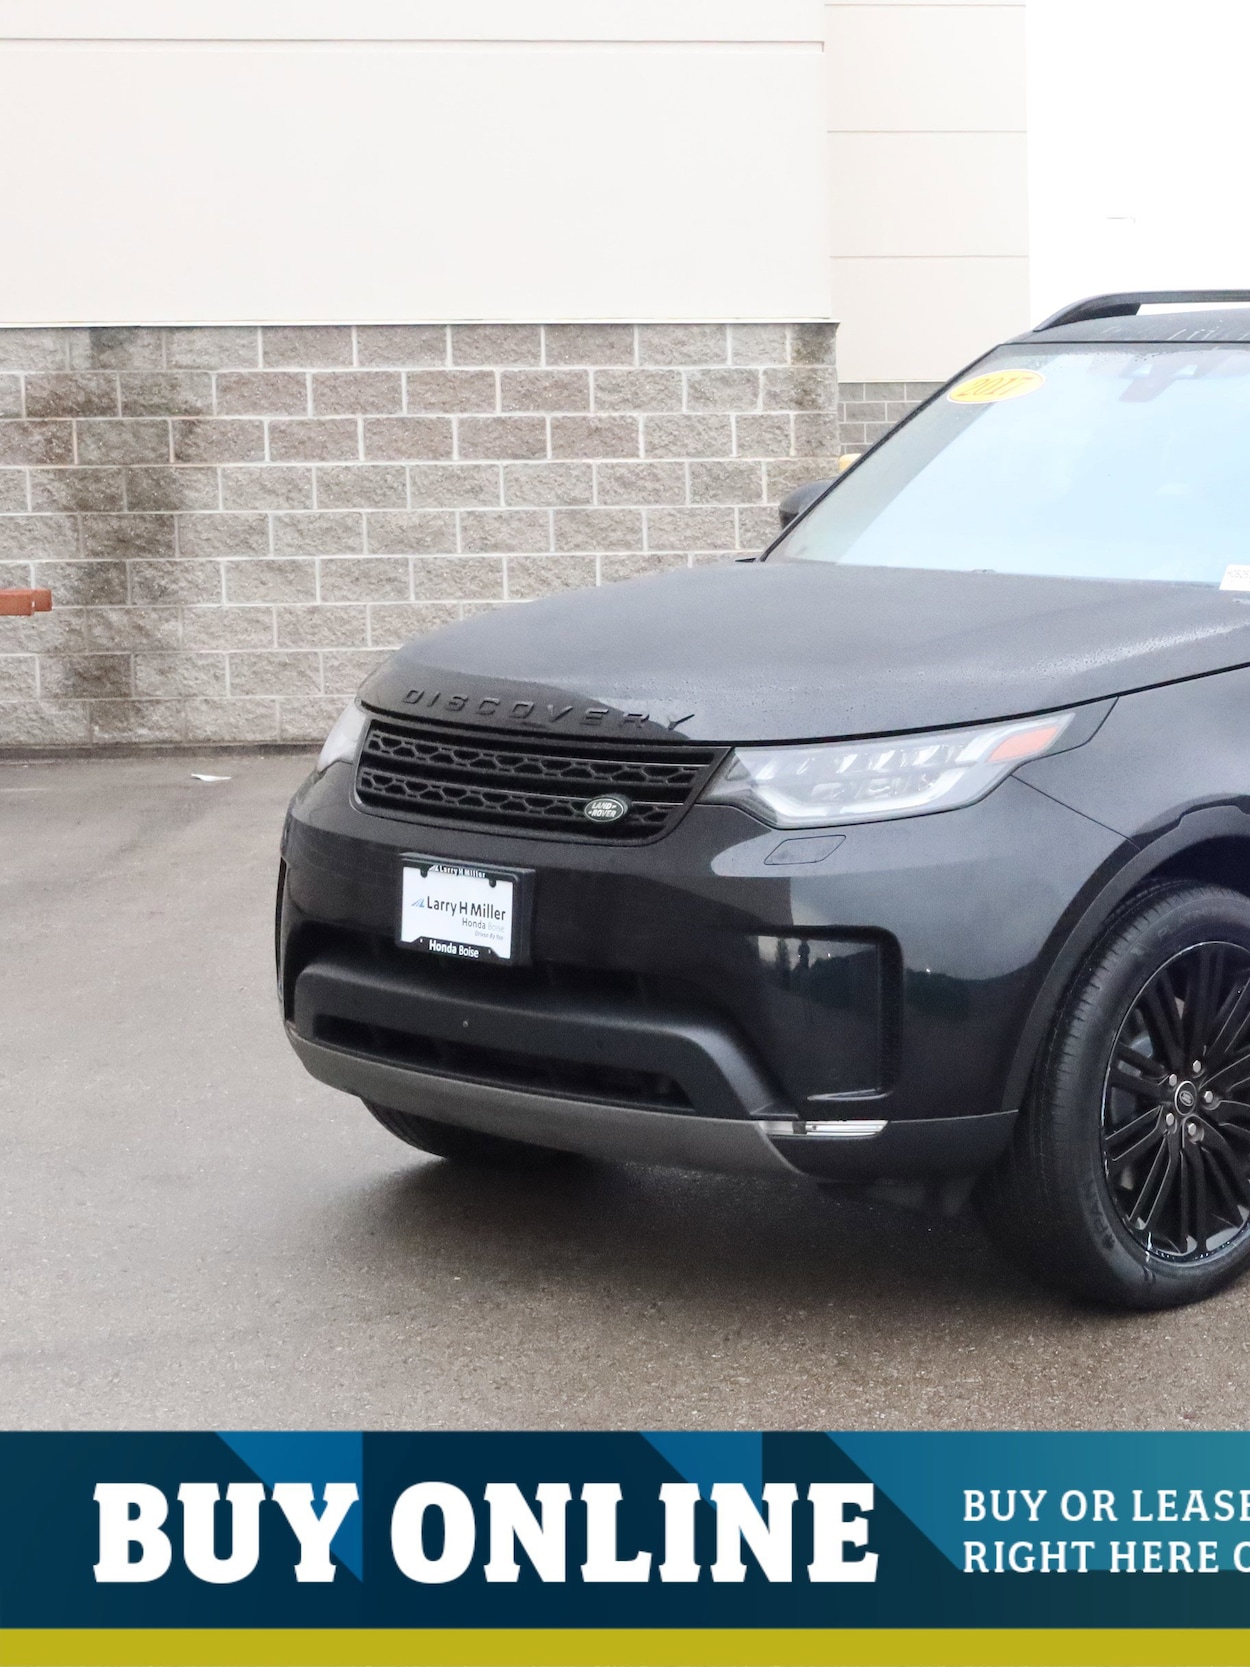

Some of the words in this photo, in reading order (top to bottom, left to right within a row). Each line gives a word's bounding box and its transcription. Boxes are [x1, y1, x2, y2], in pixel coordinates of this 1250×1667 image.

[402, 688, 696, 731] DISCOVERY
[427, 896, 457, 917] Larry
[459, 901, 468, 915] H
[471, 904, 506, 920] Miller
[462, 918, 486, 930] Honda
[429, 939, 457, 954] Honda
[458, 944, 480, 959] Boise
